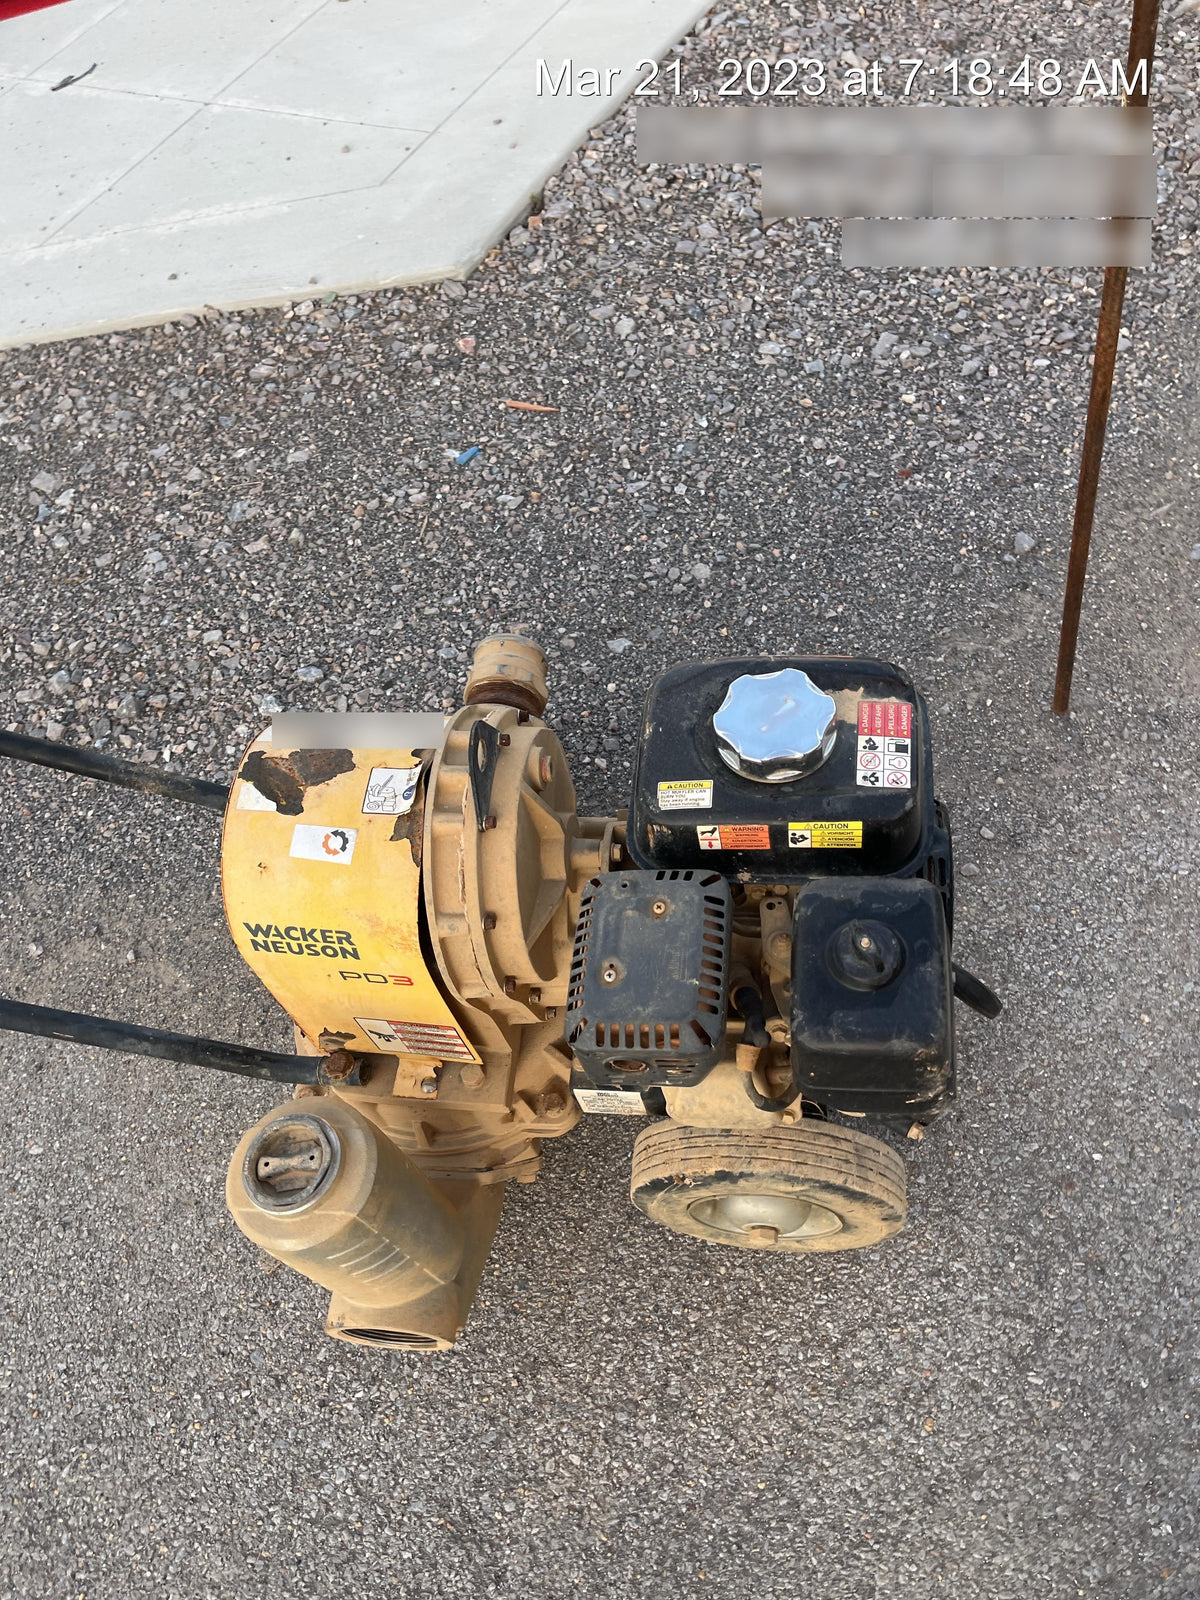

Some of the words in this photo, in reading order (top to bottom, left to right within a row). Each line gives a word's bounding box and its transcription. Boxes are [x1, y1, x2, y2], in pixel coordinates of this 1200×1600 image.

[243, 922, 356, 946] WACKER
[250, 938, 361, 960] NEUSON
[338, 970, 415, 987] PD3
